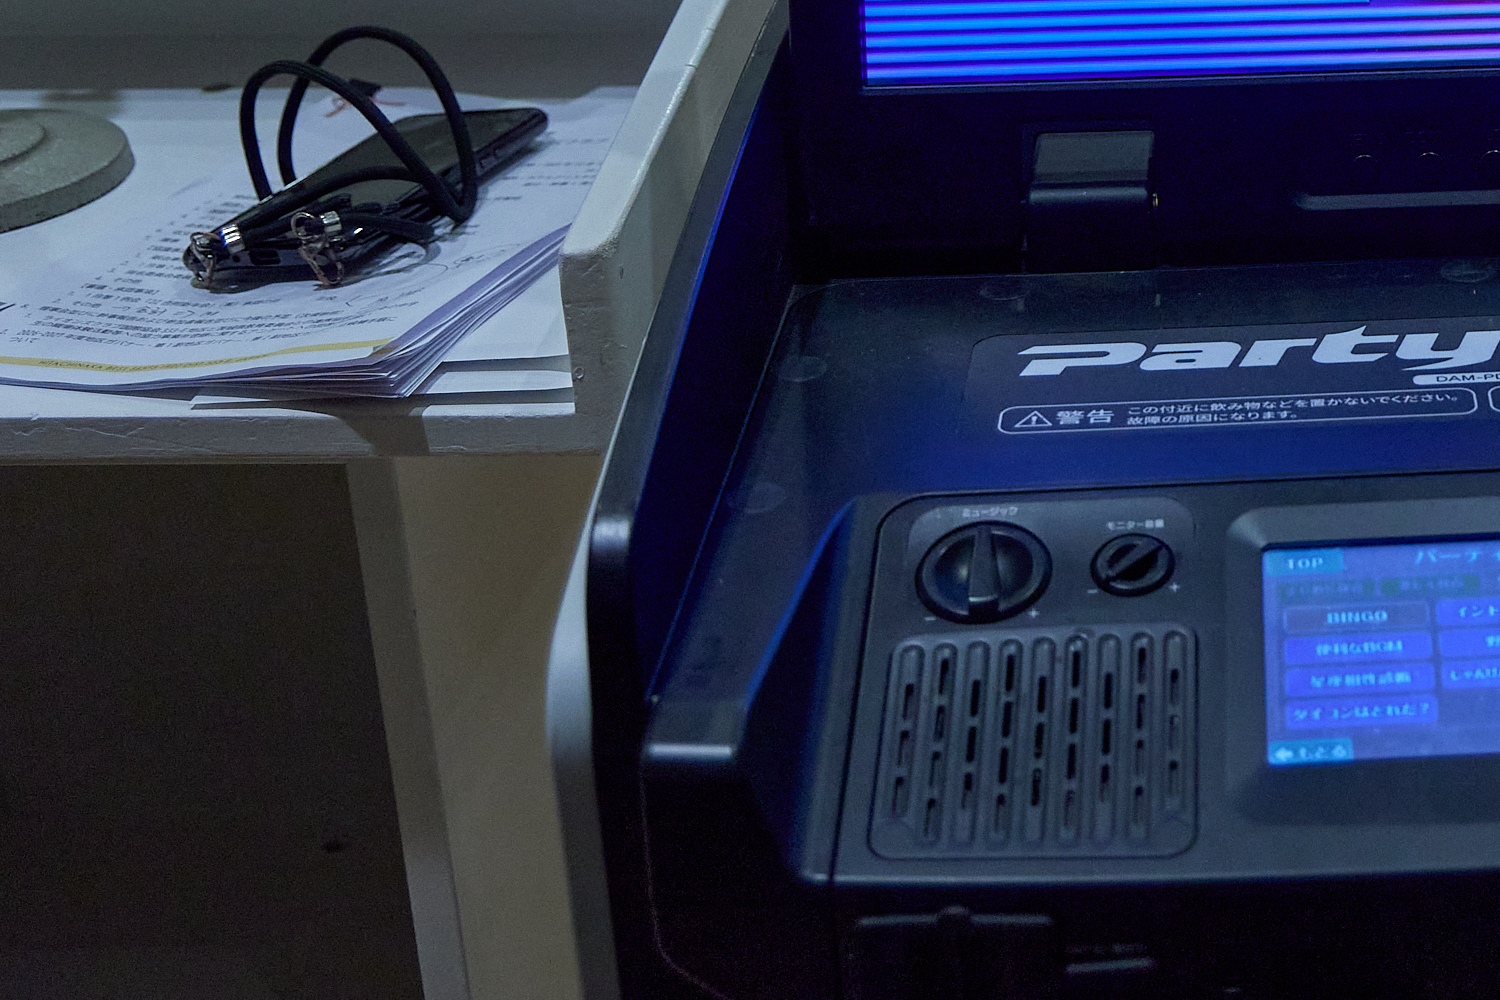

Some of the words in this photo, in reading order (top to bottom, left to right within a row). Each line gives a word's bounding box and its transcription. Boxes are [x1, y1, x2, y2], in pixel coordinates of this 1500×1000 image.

[1057, 408, 1115, 425] 警告
[1287, 556, 1324, 571] TOP
[1326, 610, 1389, 625] BINGO
